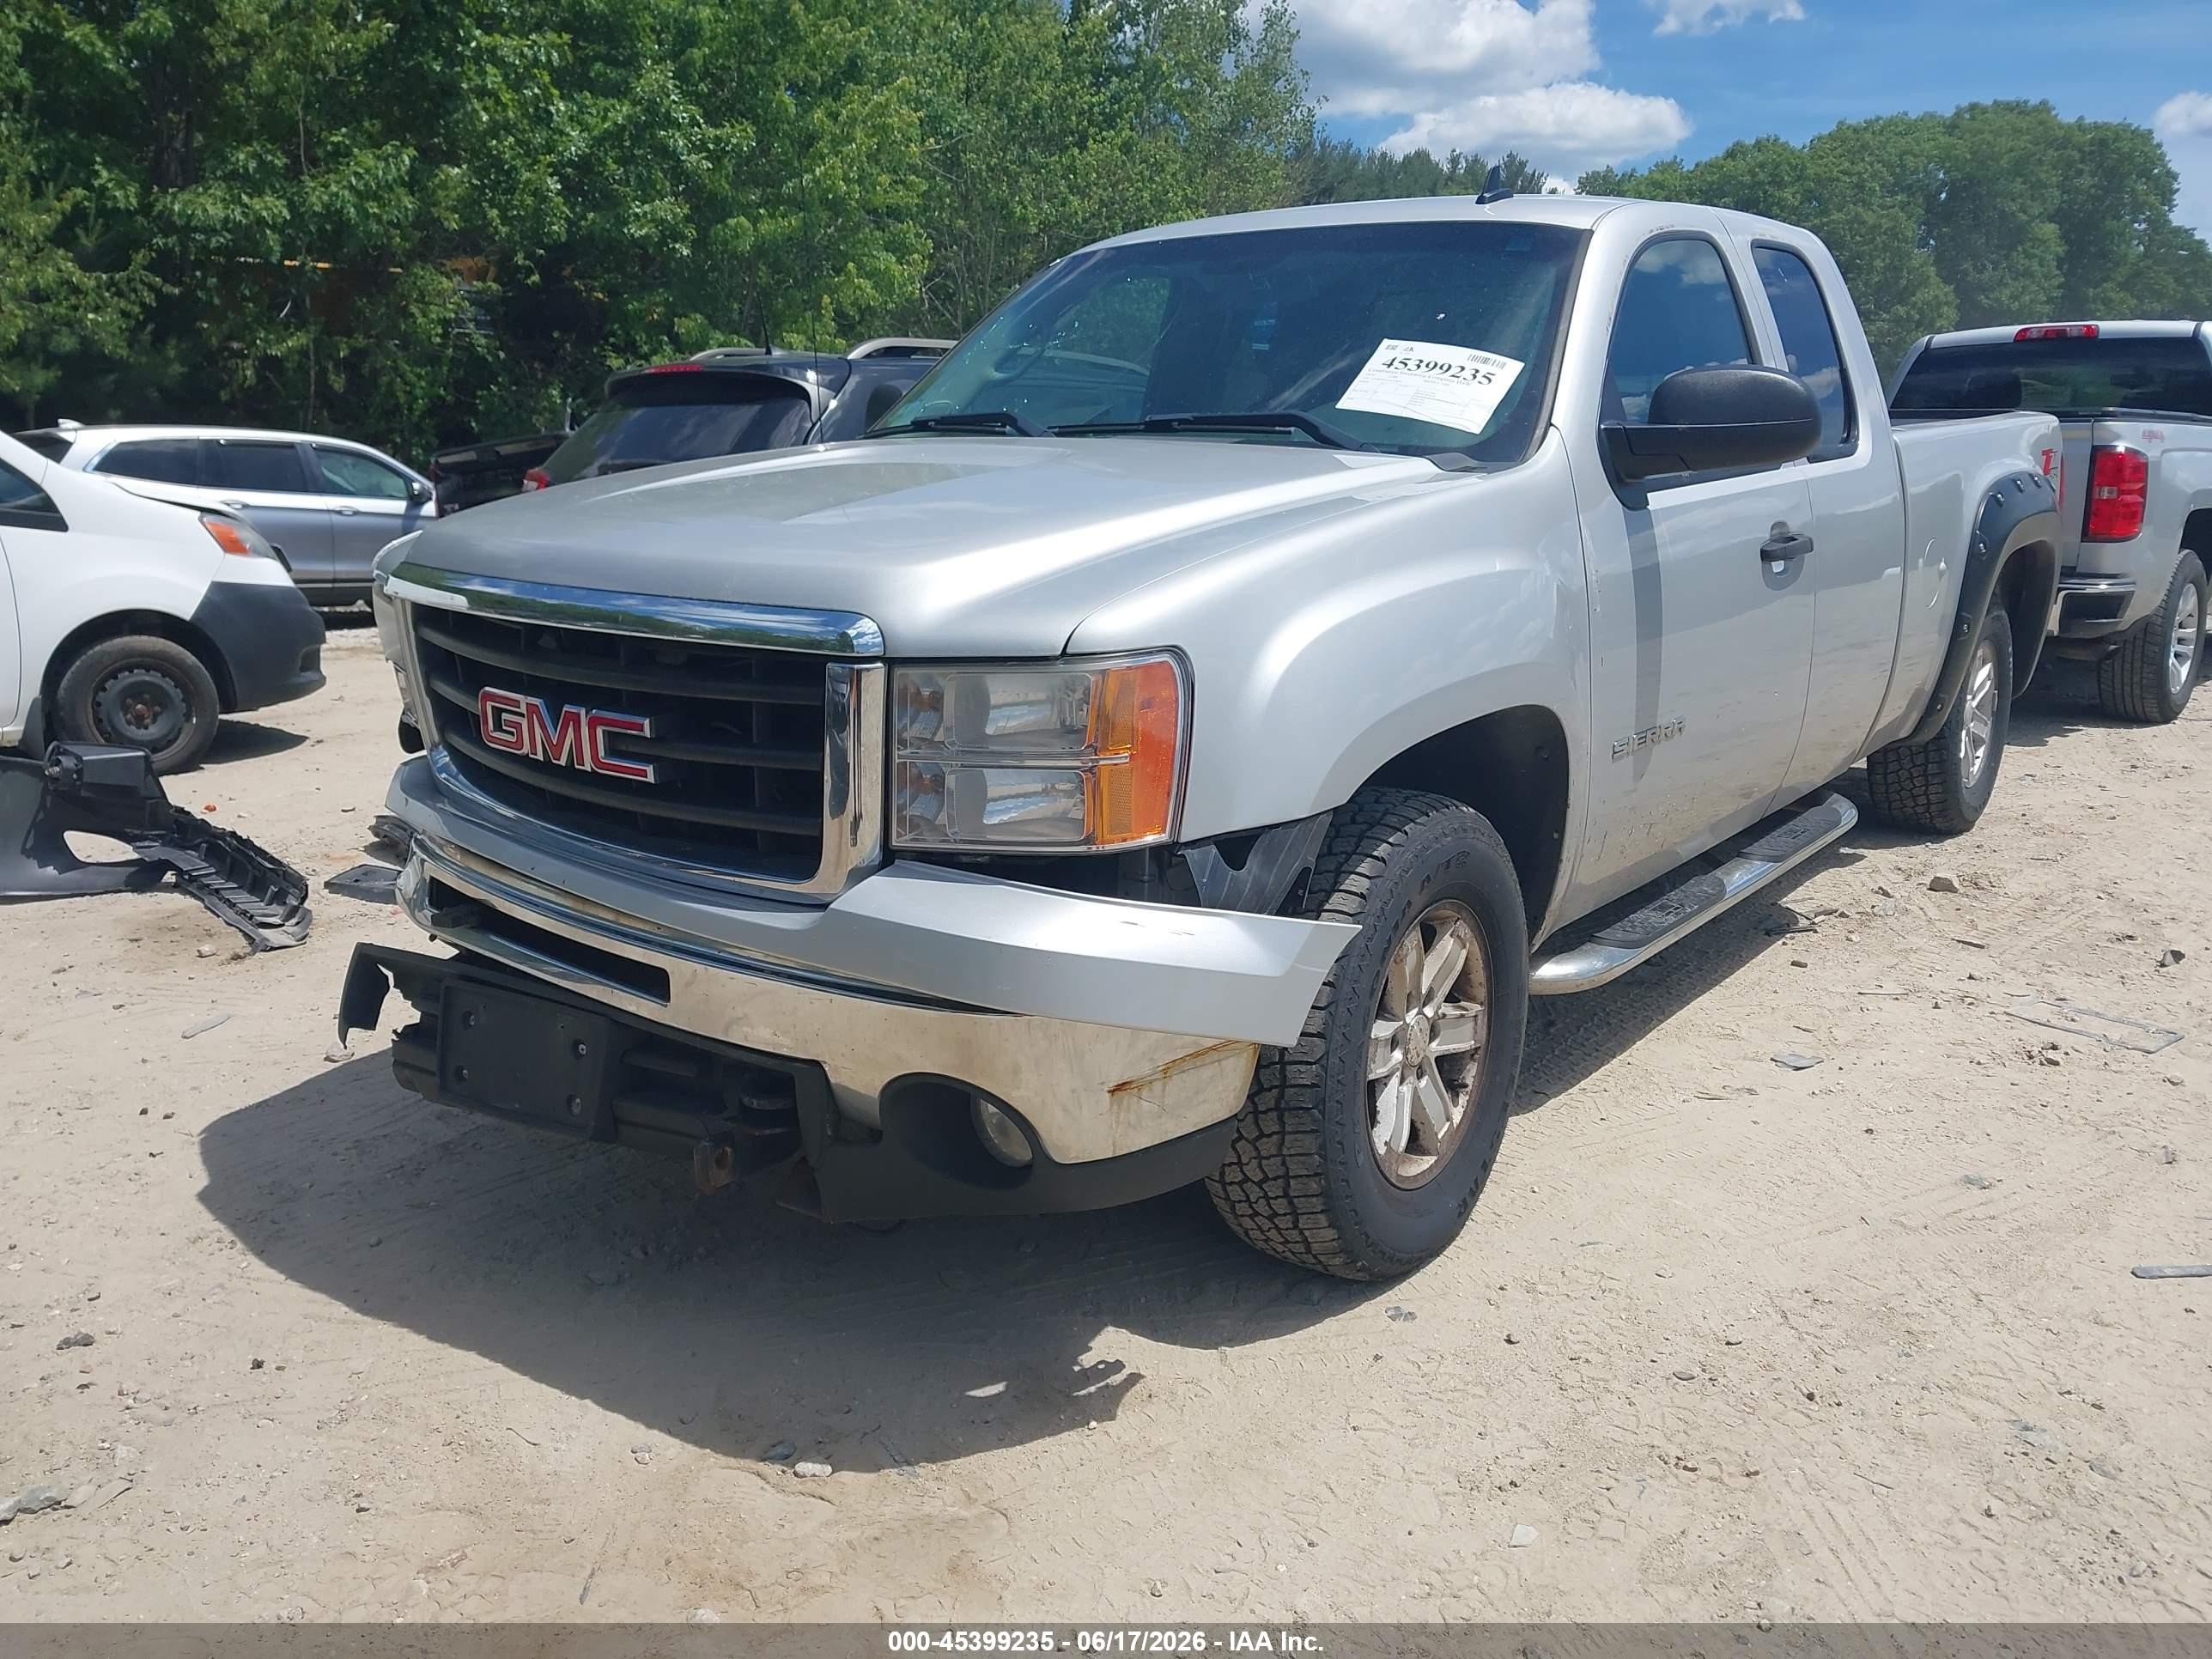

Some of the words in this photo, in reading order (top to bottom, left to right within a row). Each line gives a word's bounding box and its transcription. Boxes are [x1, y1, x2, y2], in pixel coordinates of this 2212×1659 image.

[1382, 356, 1498, 385] 45399235
[478, 686, 655, 784] GMC
[1611, 719, 1689, 762] SIERRA
